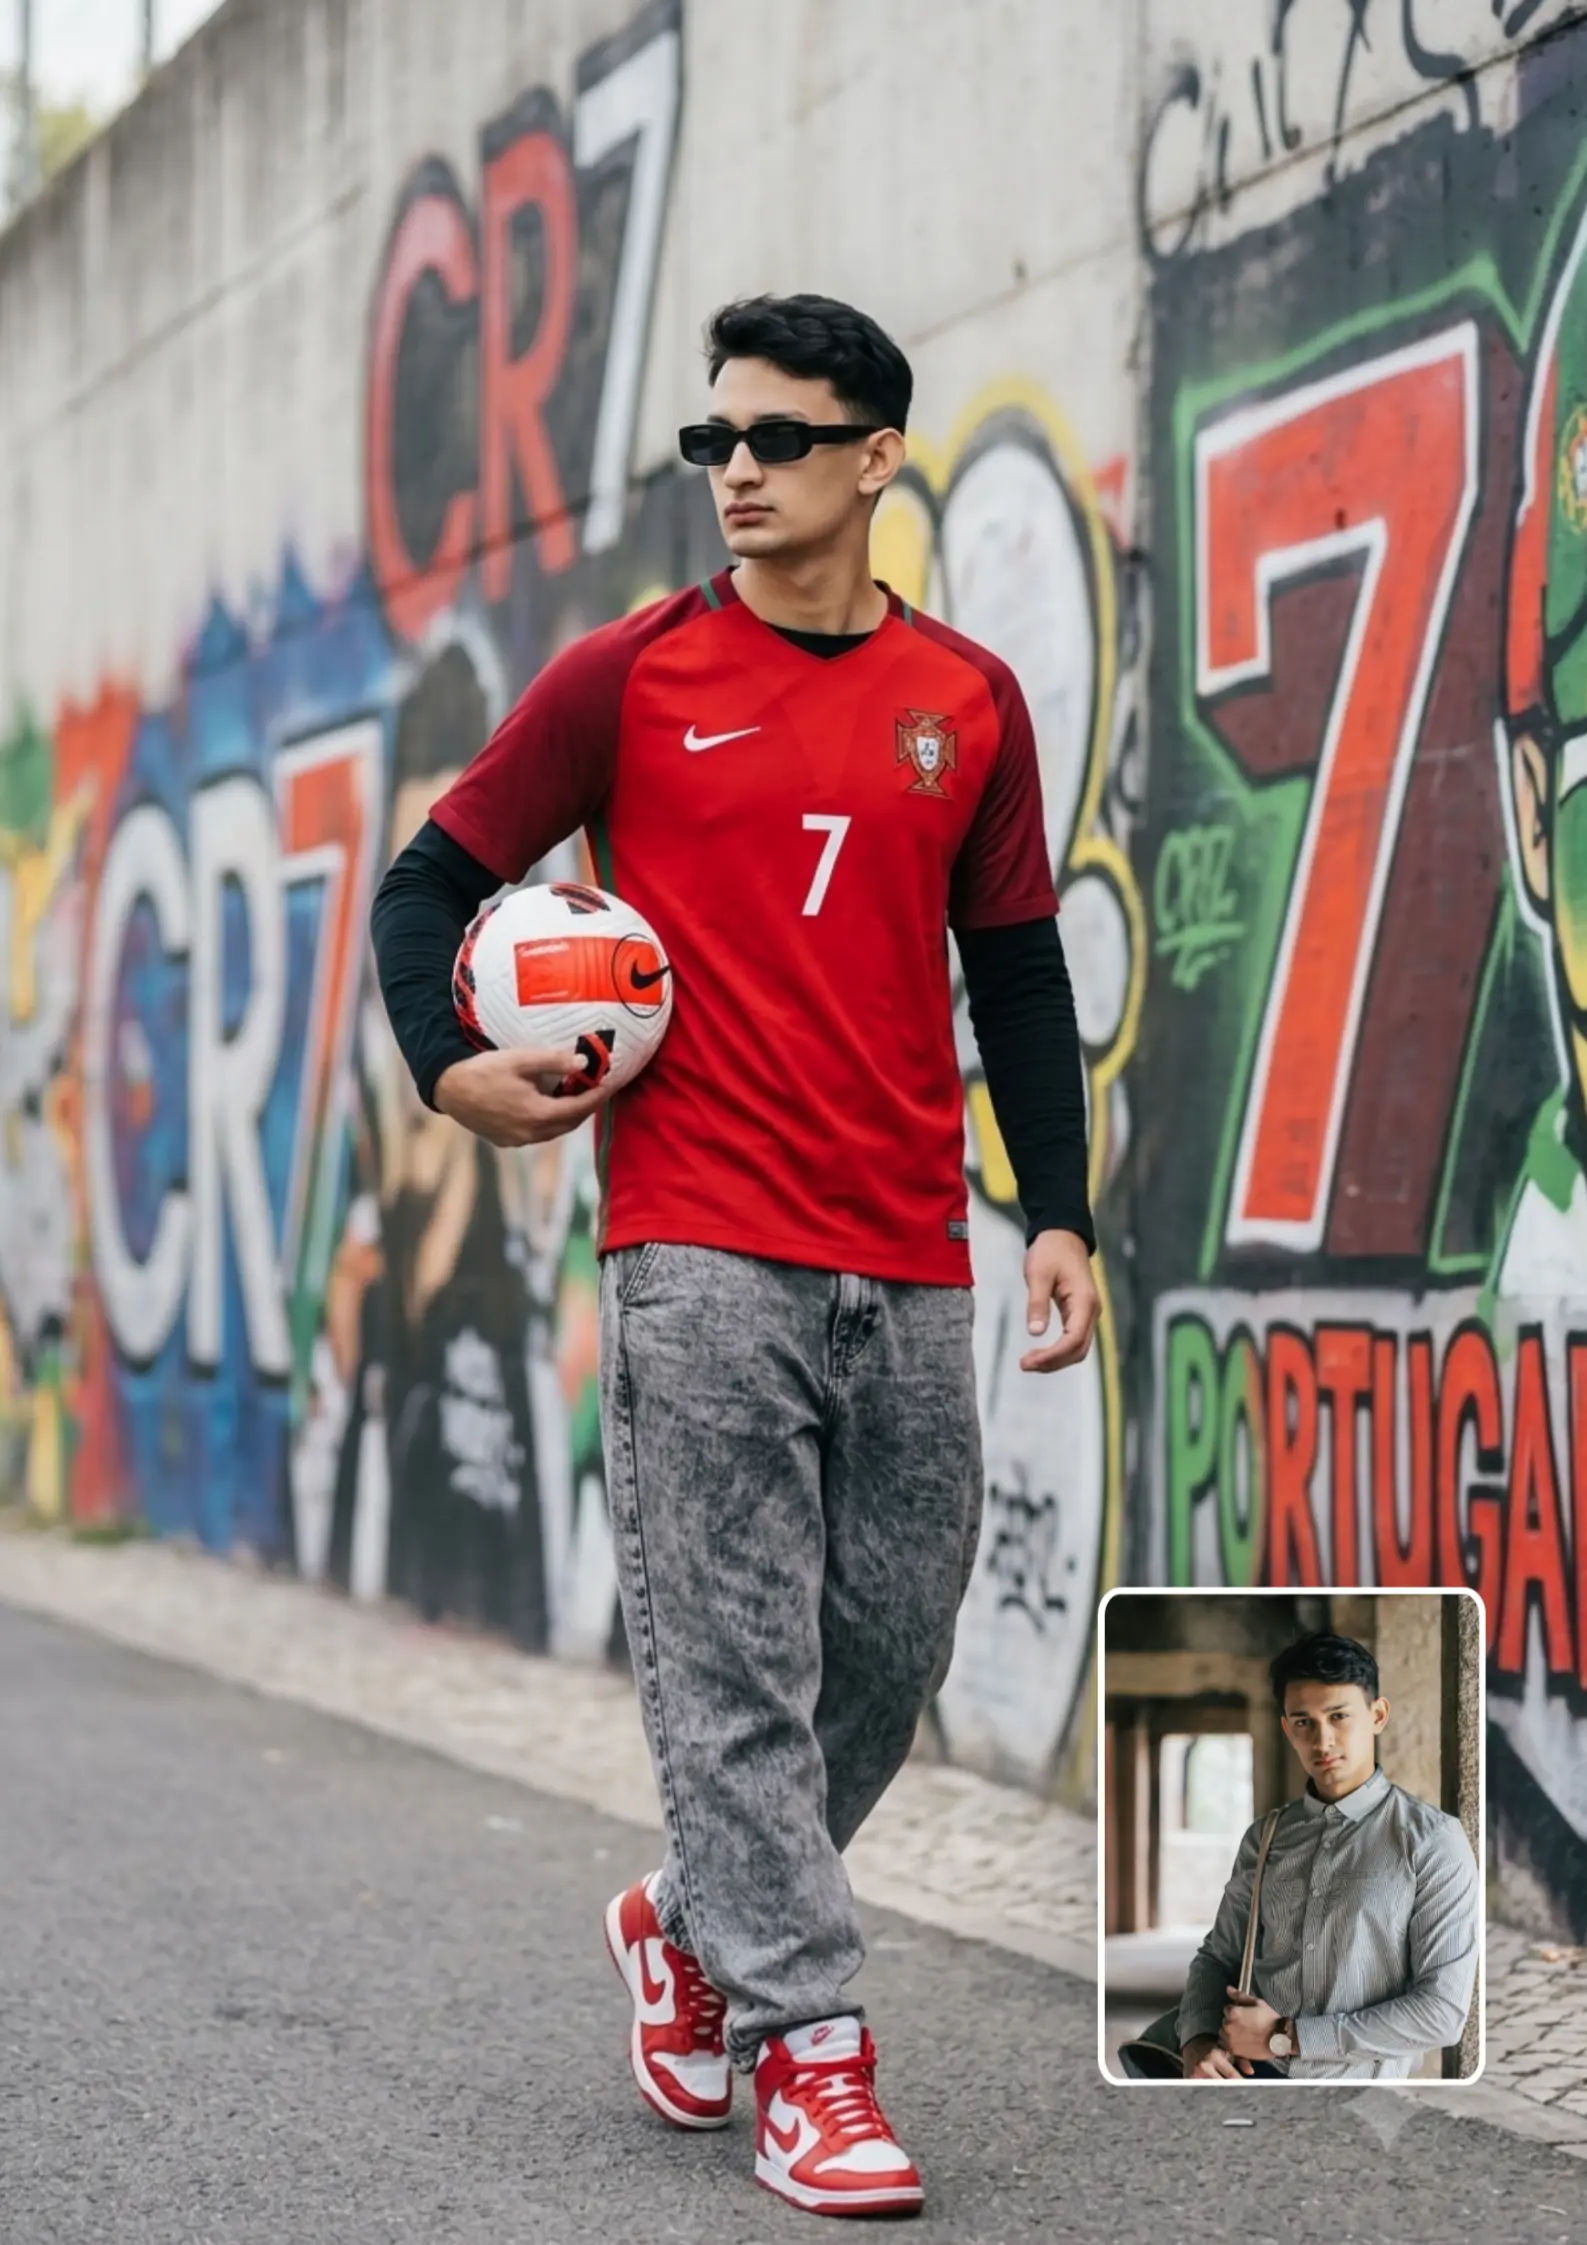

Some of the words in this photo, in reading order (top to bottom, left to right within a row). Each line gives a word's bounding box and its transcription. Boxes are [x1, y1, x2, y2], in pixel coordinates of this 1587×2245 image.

[364, 30, 680, 640] CR7
[88, 722, 379, 1376] CR7
[802, 813, 852, 917] 7
[1196, 320, 1478, 1252] 7
[1167, 1312, 1587, 1694] PORTUGA
